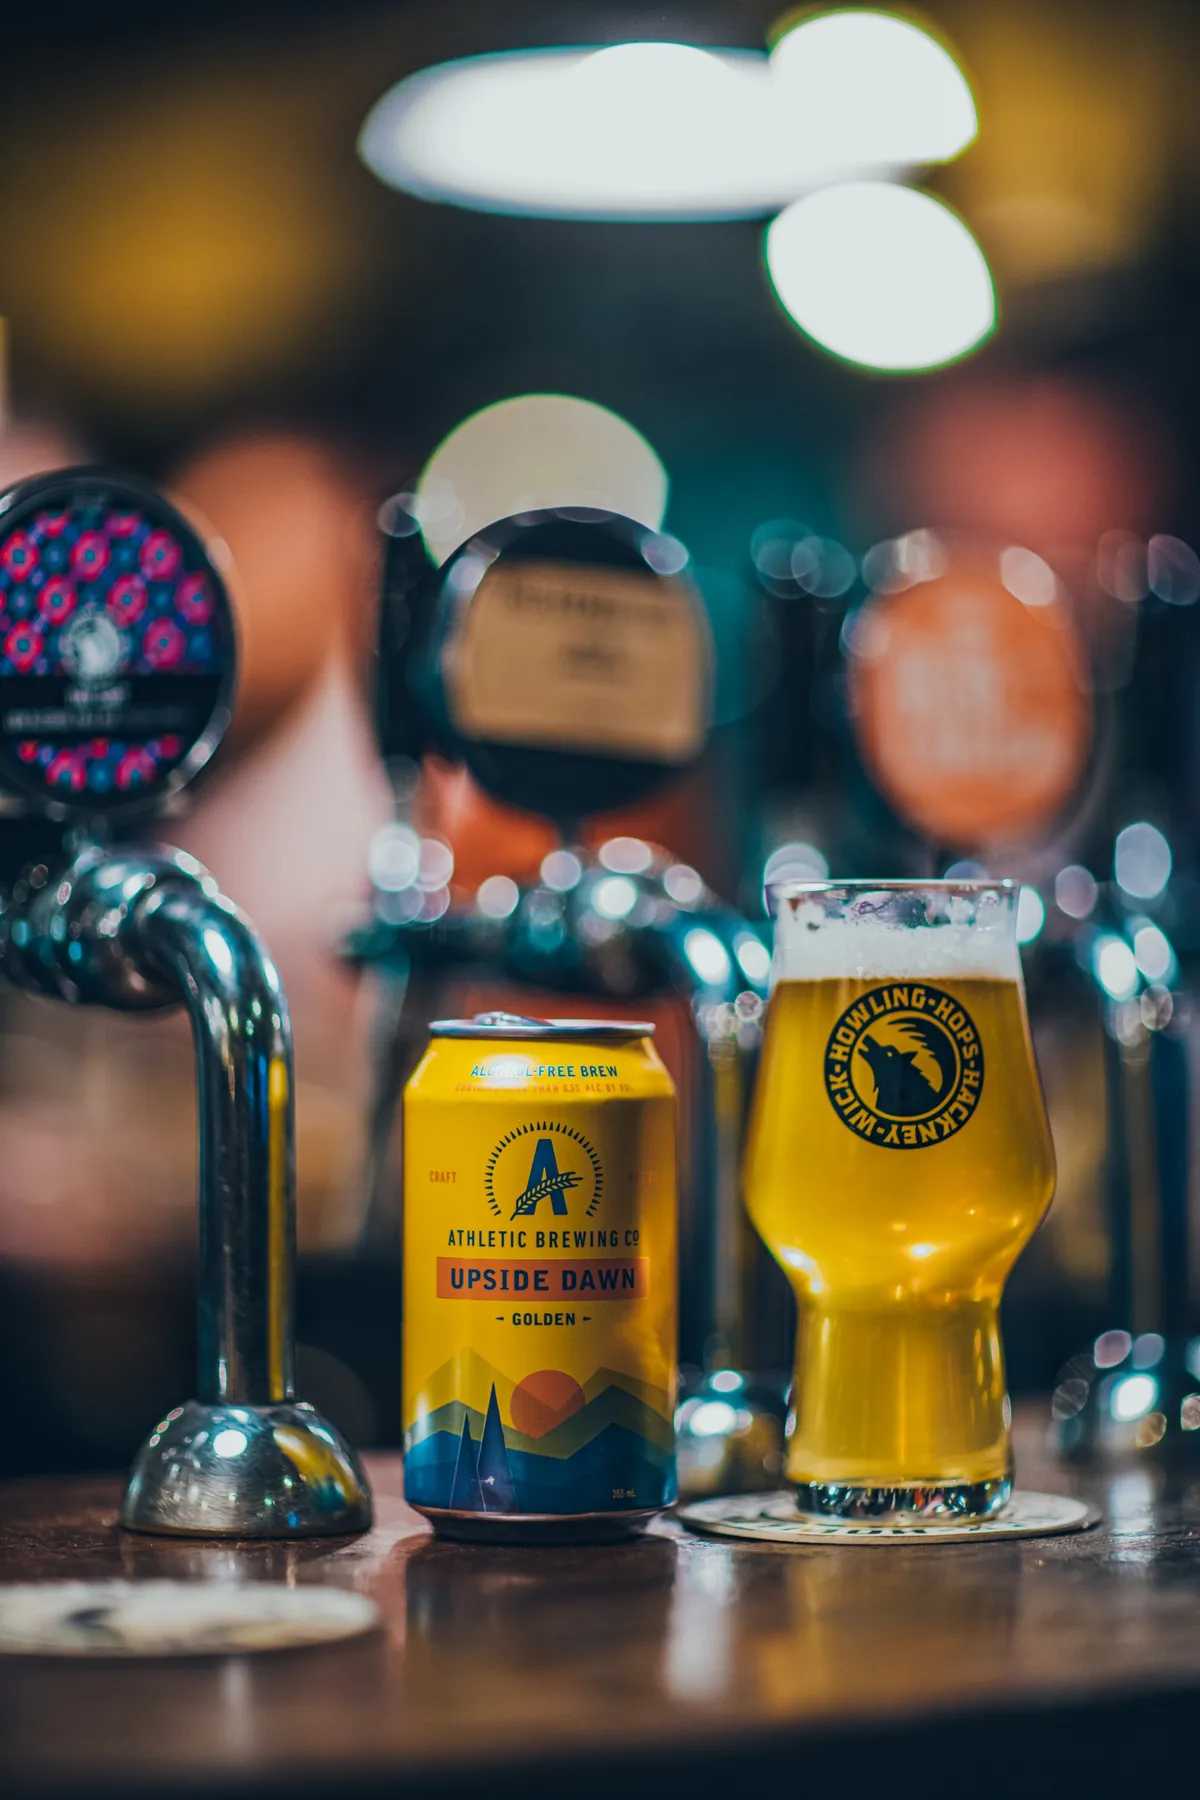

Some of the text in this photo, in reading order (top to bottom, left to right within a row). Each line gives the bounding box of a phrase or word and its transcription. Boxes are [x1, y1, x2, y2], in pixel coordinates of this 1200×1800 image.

[580, 1065, 618, 1077] BREW
[829, 987, 980, 1144] HOWLING HOPS HACKNEY WICK
[429, 1170, 457, 1184] CRAFT
[448, 1230, 527, 1248] ATHLETIC
[535, 1230, 619, 1248] BREWING
[450, 1268, 635, 1291] UPSIDE DAWN
[512, 1313, 576, 1326] GOLDEN
